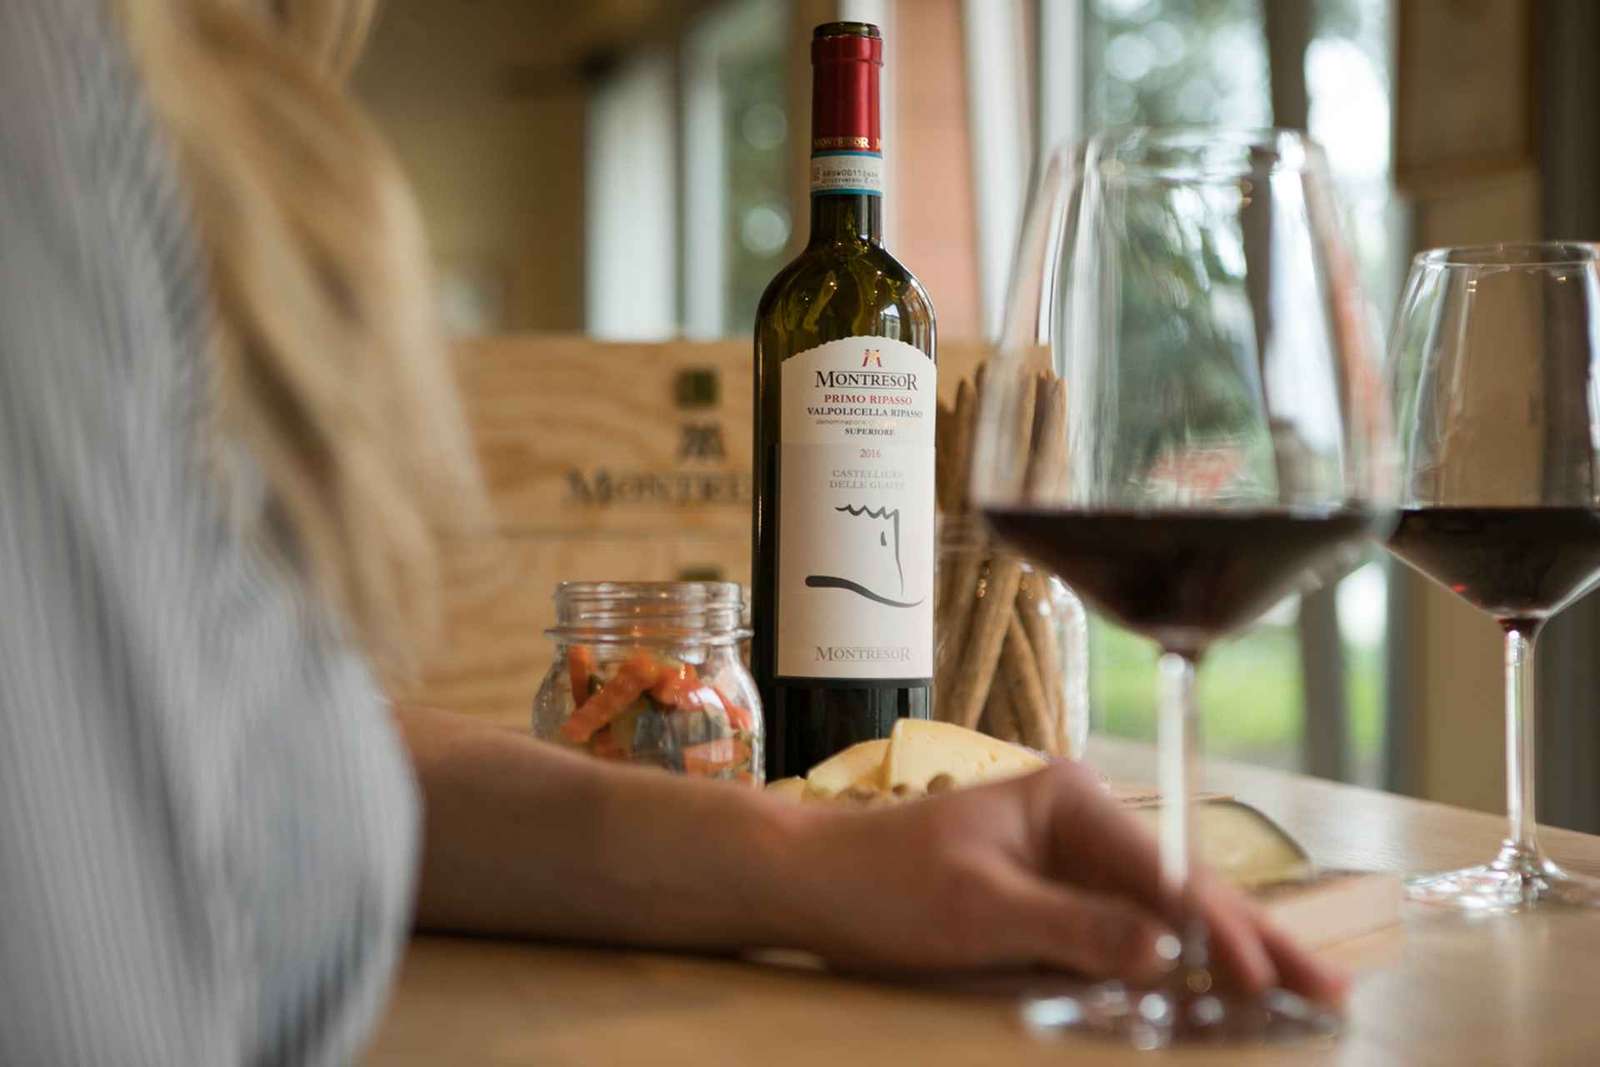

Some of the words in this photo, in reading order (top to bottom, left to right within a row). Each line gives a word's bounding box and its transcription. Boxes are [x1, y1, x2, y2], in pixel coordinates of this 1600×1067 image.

[815, 370, 918, 391] MONTRESOR
[824, 394, 866, 404] PRIMO
[870, 394, 912, 405] RIPASSO
[807, 407, 888, 417] VALPOLICELLA
[890, 409, 923, 418] RIPASSO
[844, 427, 895, 436] SUPERIORE
[815, 646, 911, 662] MONTRESOR
